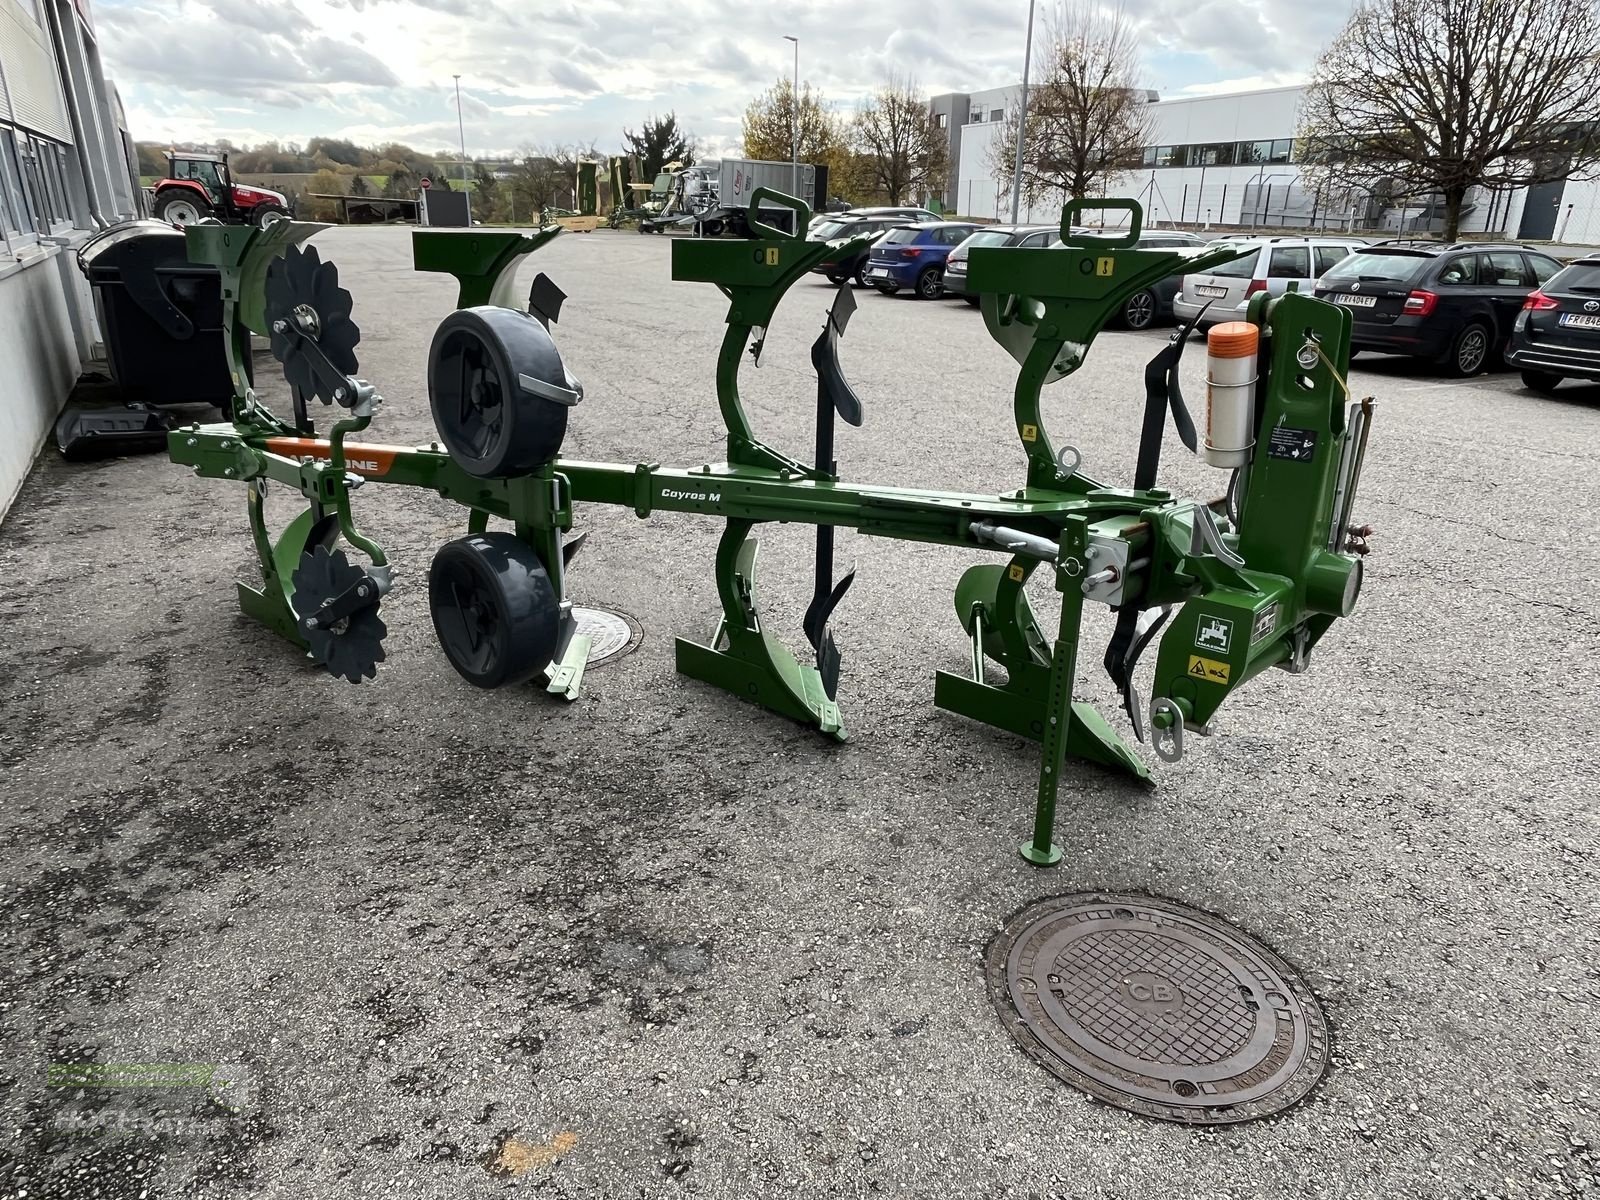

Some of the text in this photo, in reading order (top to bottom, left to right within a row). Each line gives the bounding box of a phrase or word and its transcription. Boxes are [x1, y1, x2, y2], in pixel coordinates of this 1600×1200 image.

[1568, 313, 1580, 324] FR
[661, 488, 721, 502] Cayros M
[1129, 983, 1174, 1002] CB
